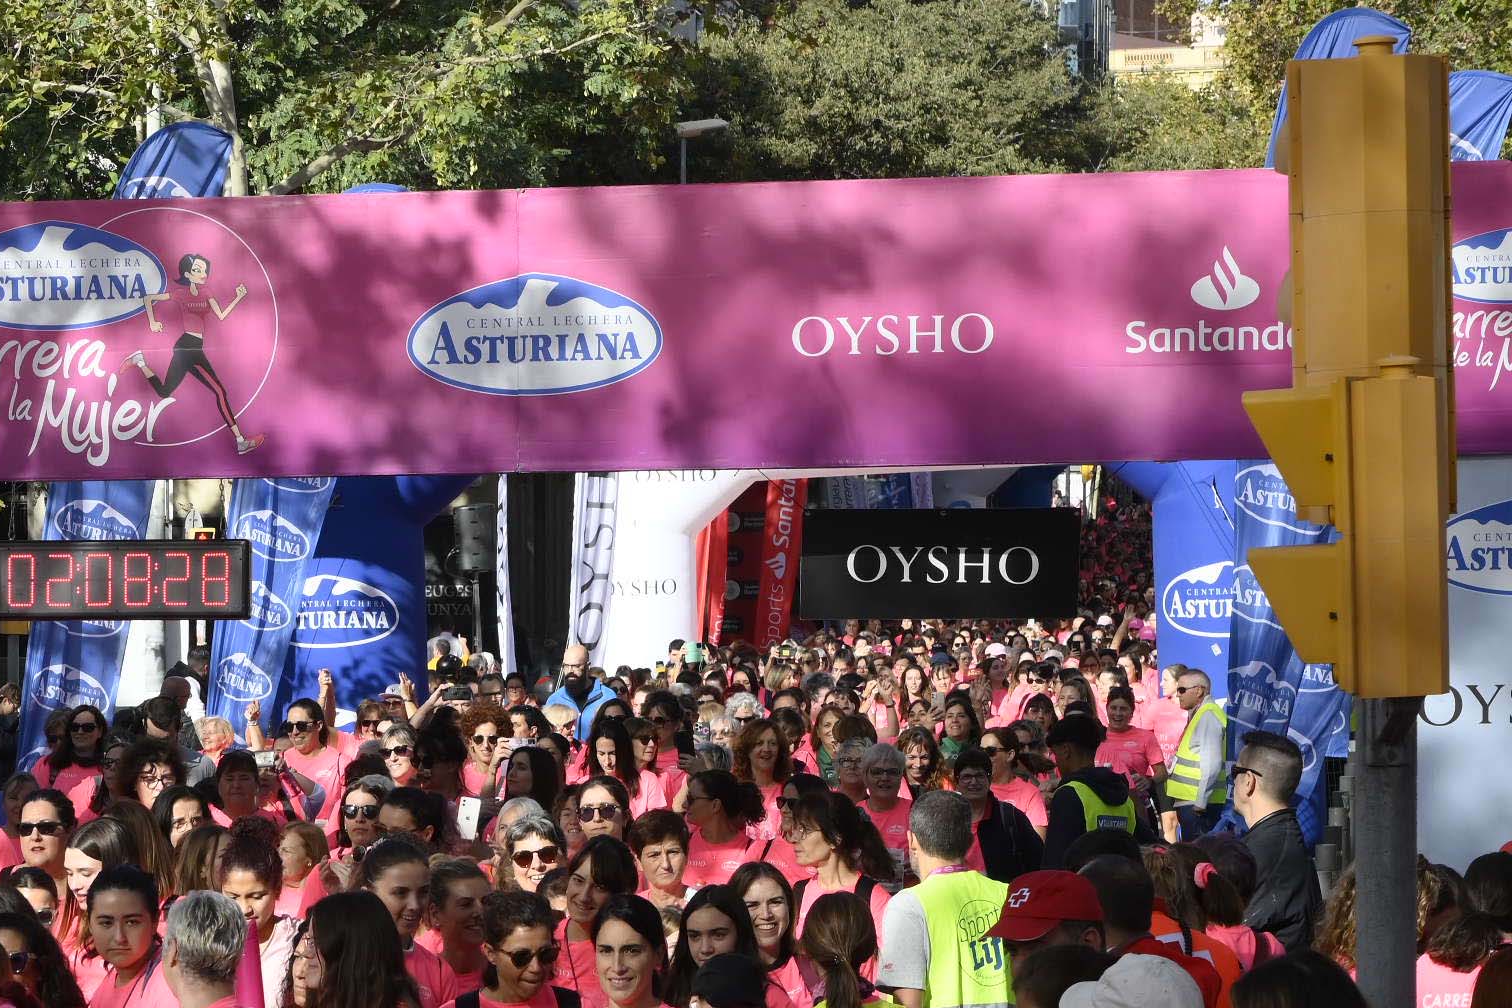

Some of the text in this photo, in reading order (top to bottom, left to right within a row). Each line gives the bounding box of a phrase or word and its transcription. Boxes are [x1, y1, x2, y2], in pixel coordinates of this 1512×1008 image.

[69, 257, 142, 269] LECHERA
[466, 313, 634, 329] CENTRAL LECHERA
[791, 311, 995, 357] OYSHO
[1453, 310, 1512, 338] arre
[427, 321, 644, 365] ASTURIANA
[1476, 339, 1493, 367] la
[8, 383, 32, 422] la
[28, 373, 177, 466] Mujer
[7, 551, 230, 608] 02:08:28
[846, 543, 1040, 585] OYSHO
[296, 611, 389, 630] TURIANA
[959, 905, 999, 942] Sport
[1423, 993, 1471, 1008] CARRE
